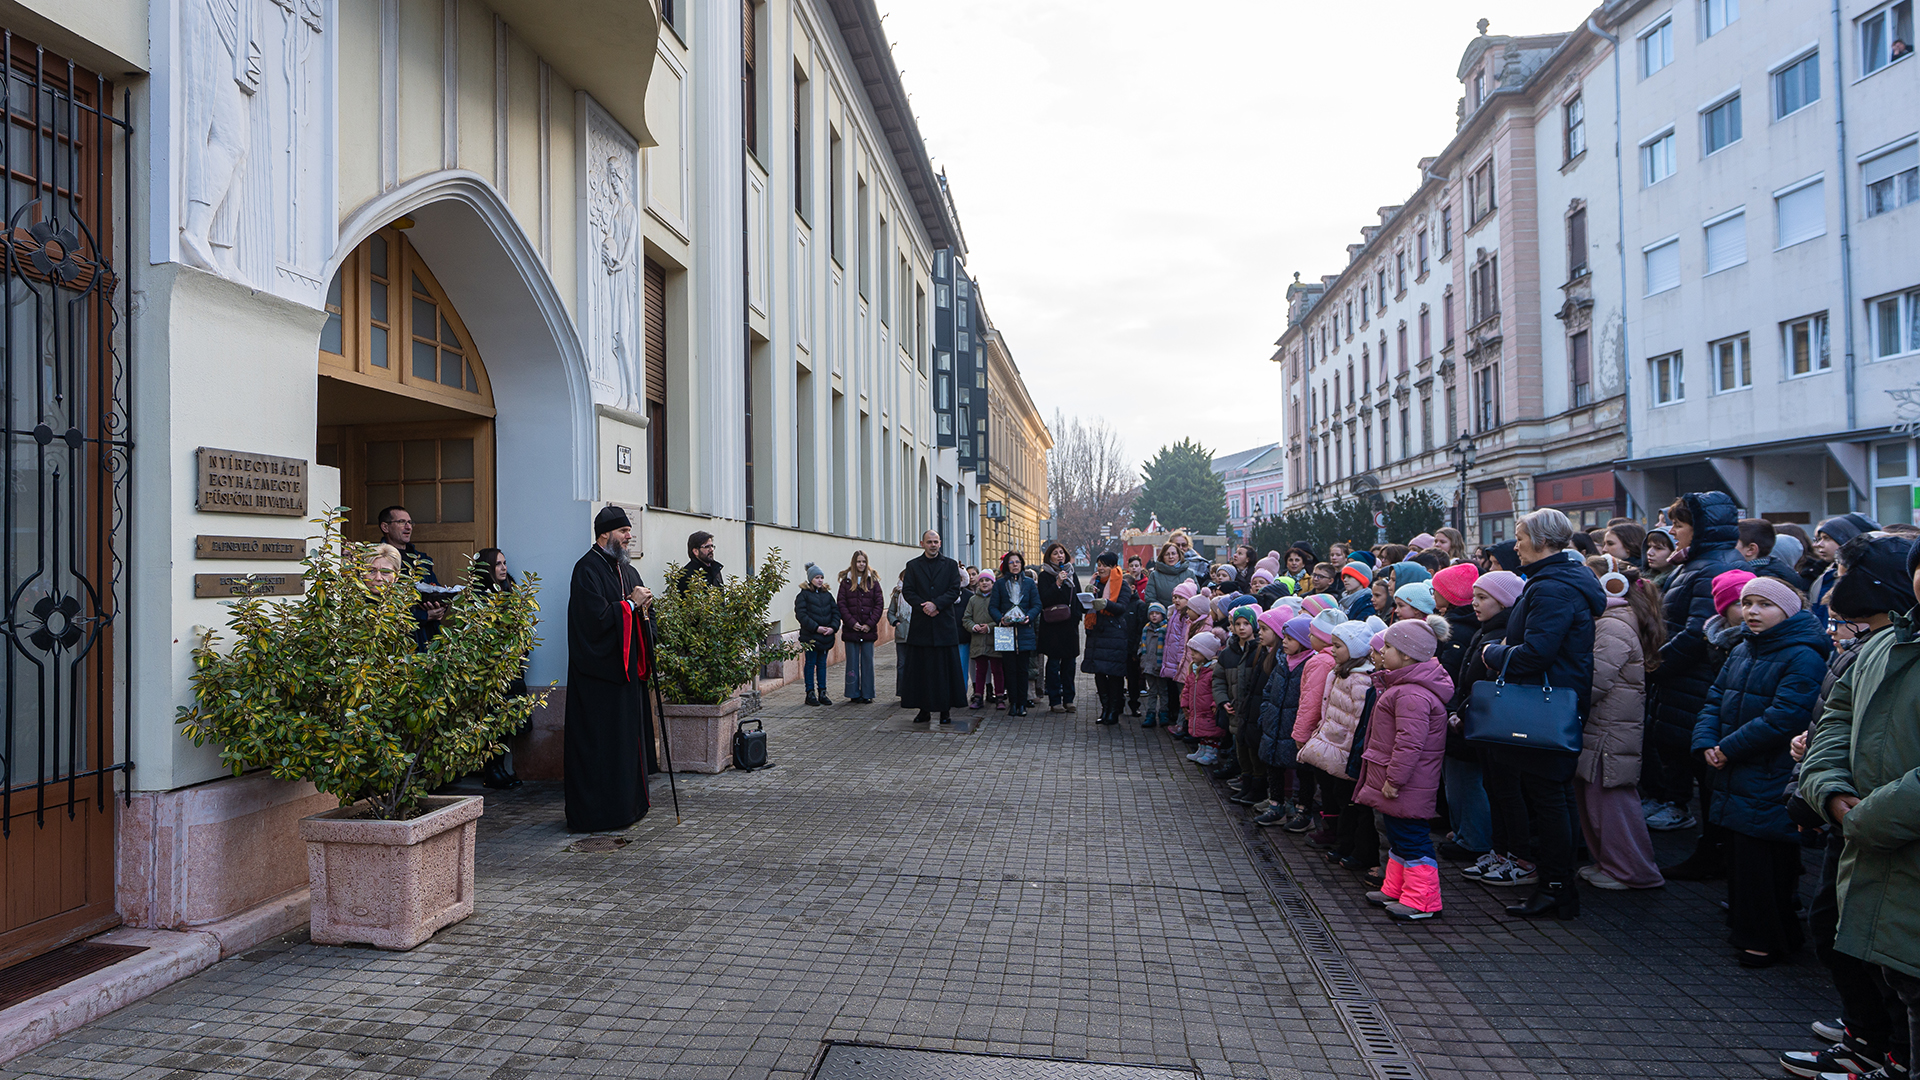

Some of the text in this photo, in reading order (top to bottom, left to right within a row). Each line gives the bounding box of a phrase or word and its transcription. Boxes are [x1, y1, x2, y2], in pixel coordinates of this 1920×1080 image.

[209, 454, 300, 477] NYÍREGYHÁZI
[209, 473, 300, 493] EGYHÁZMEGYE
[205, 489, 303, 510] PÜSPÖKI HIVATALA
[262, 542, 294, 553] INTÉZET
